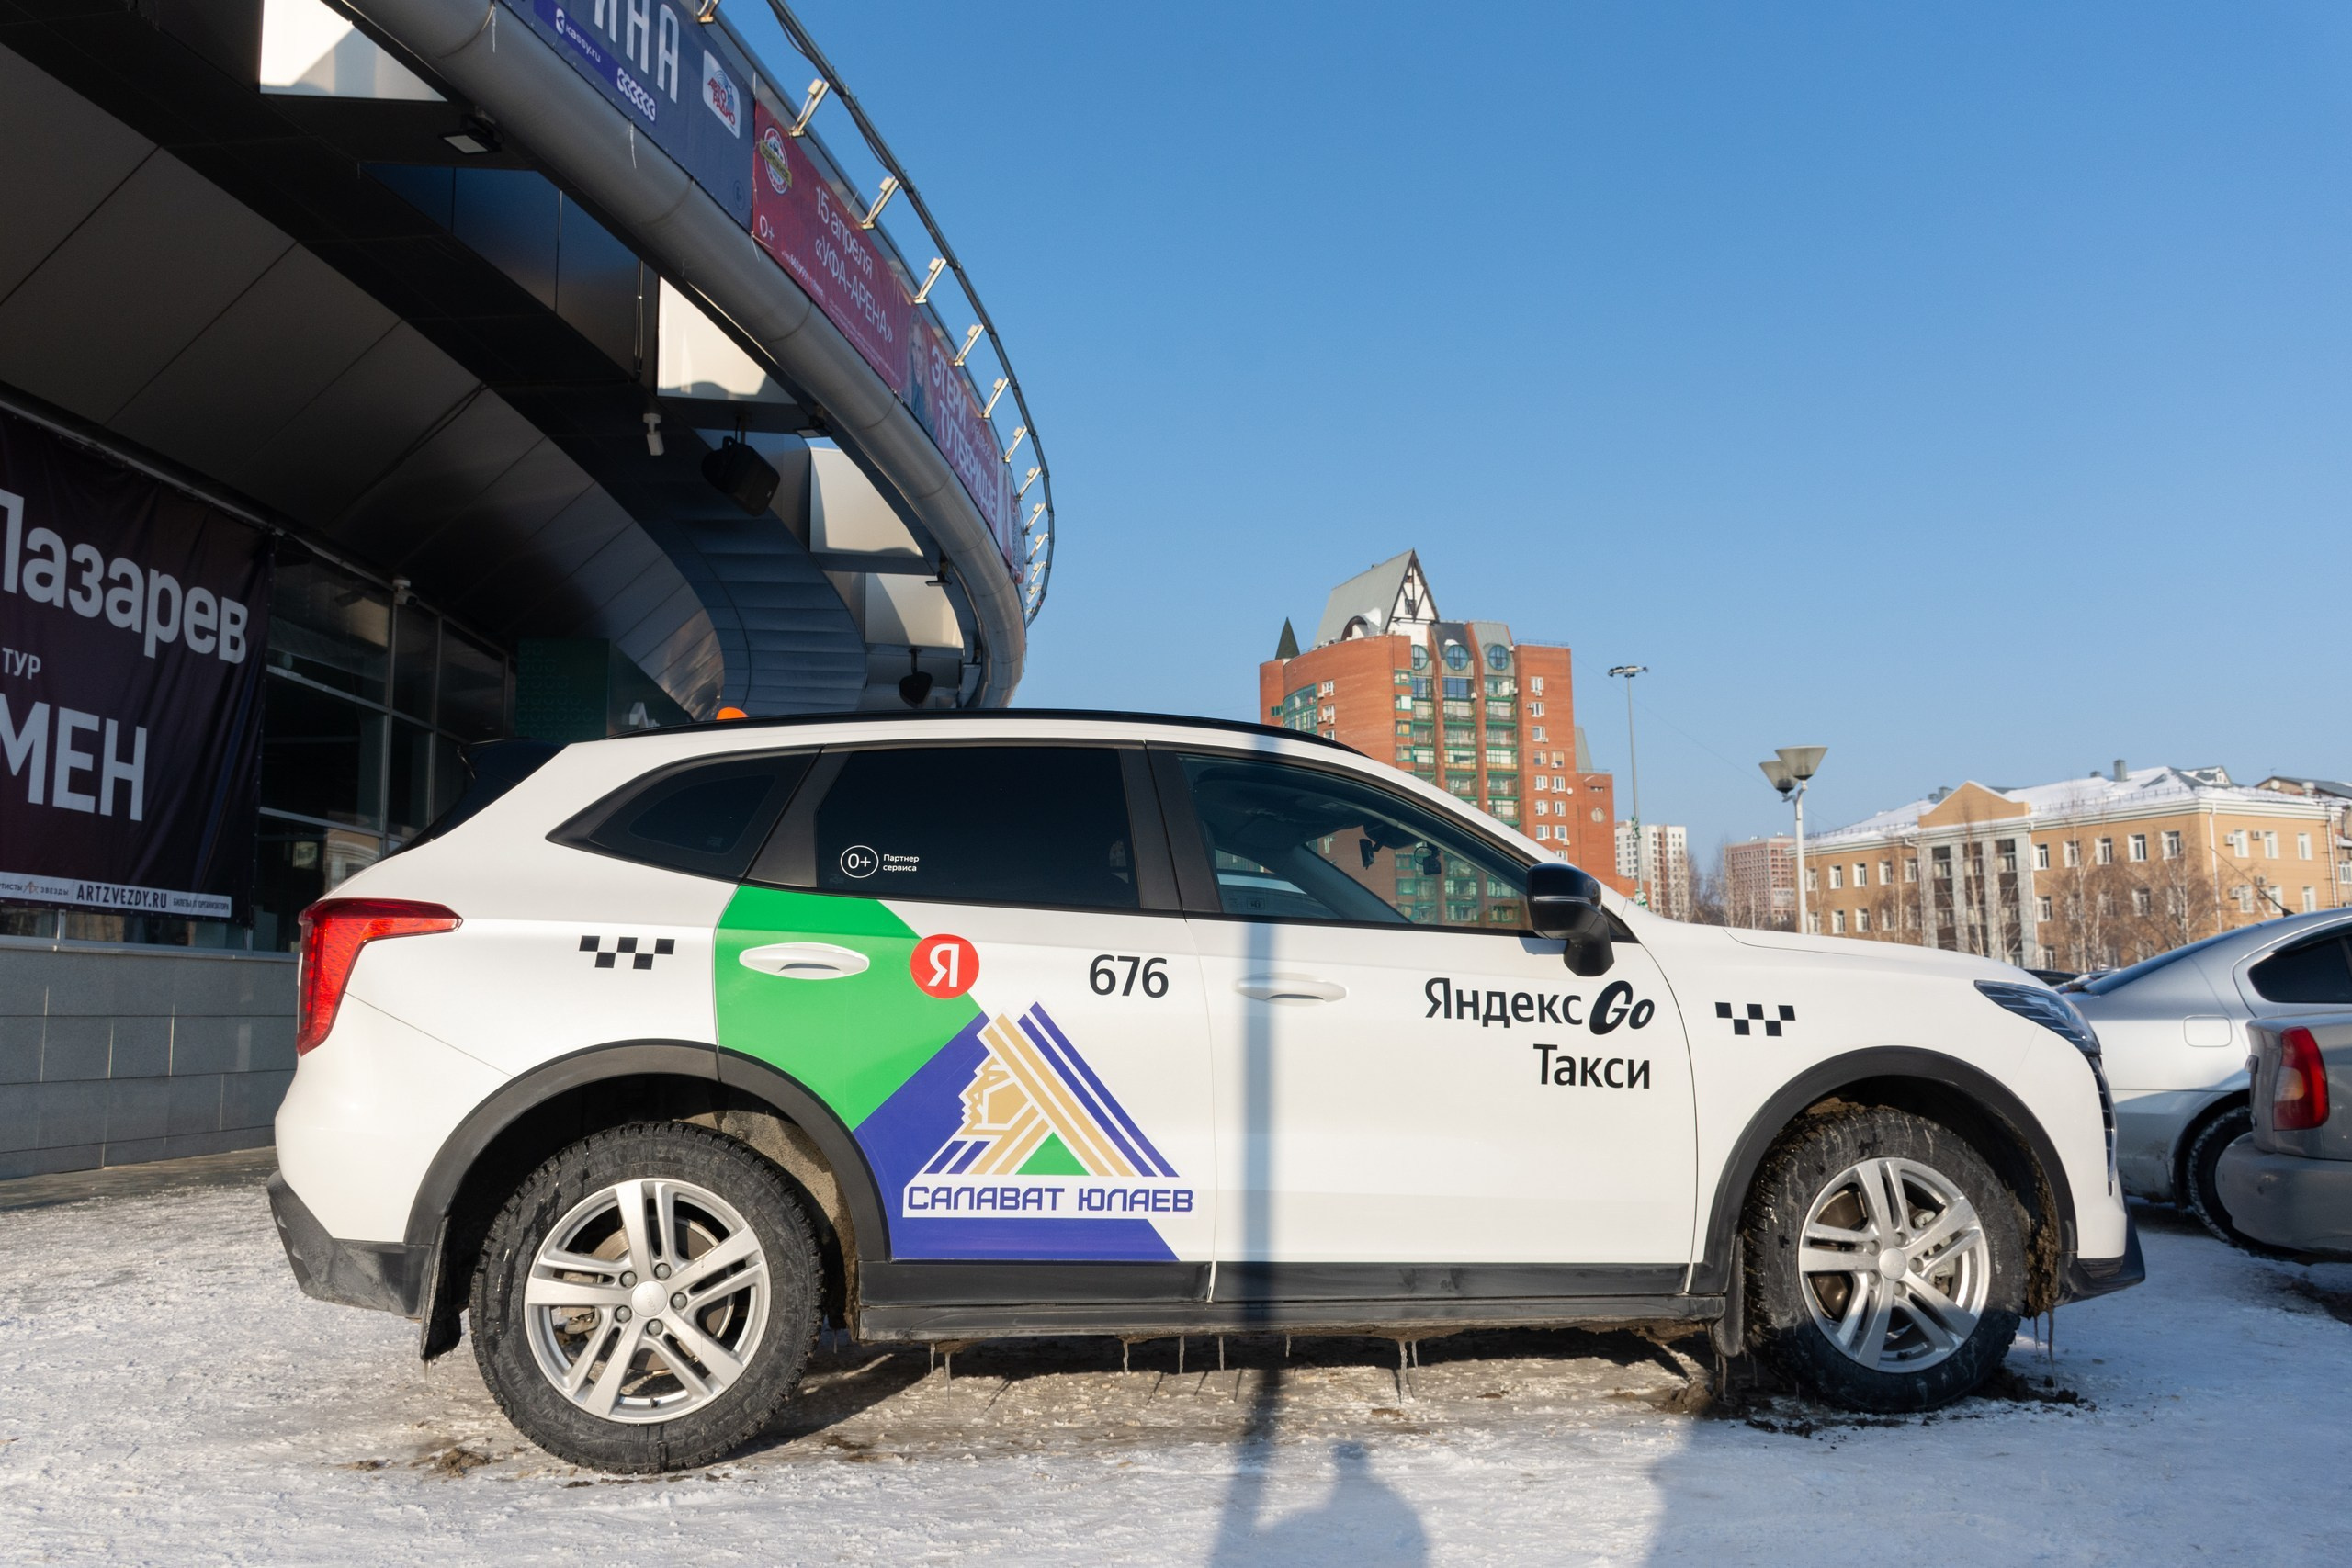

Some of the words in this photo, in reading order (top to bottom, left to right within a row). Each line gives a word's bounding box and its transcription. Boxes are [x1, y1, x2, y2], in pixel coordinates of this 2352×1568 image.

[565, 24, 601, 63] kassy.ru
[759, 215, 775, 241] 0+
[816, 186, 829, 224] 15
[831, 210, 873, 279] апреля
[815, 235, 893, 343] «УФА-АРЕНА»
[931, 344, 967, 428] ЭТЕРИ
[2, 647, 41, 680] ТУР
[847, 853, 871, 869] 0+
[882, 864, 917, 873] сервиса
[883, 853, 920, 863] Партнер
[0, 883, 23, 891] ТИСТЫ
[76, 884, 168, 908] ARTZVEZDY.RU
[927, 943, 960, 987] Я
[1089, 954, 1169, 998] 676
[1424, 977, 1583, 1029] Яндекс
[1589, 980, 1655, 1035] Go
[1532, 1043, 1650, 1089] Такси
[908, 1186, 1065, 1212] САЛАВАТ
[1078, 1188, 1193, 1213] ЮЛАЕВ
